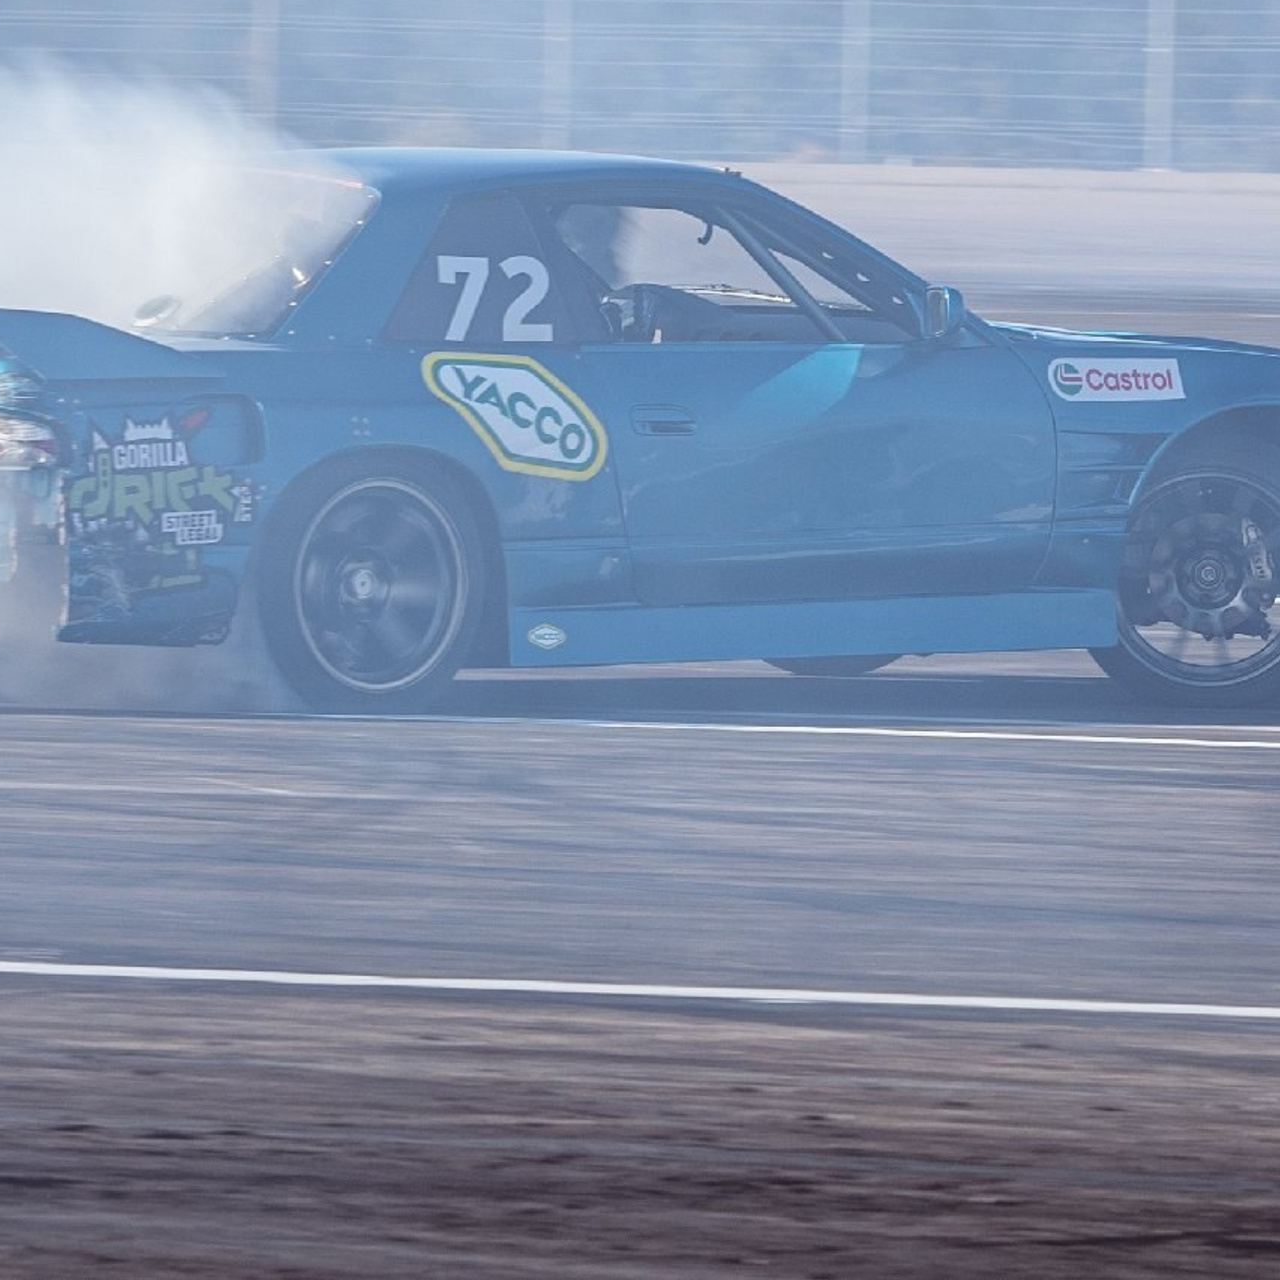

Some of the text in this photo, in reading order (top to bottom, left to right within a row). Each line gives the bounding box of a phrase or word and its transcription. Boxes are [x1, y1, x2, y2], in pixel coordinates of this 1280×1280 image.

[437, 255, 553, 341] 72
[1085, 368, 1174, 391] Castrol
[451, 365, 586, 459] YACCO
[114, 441, 190, 470] GORILLA
